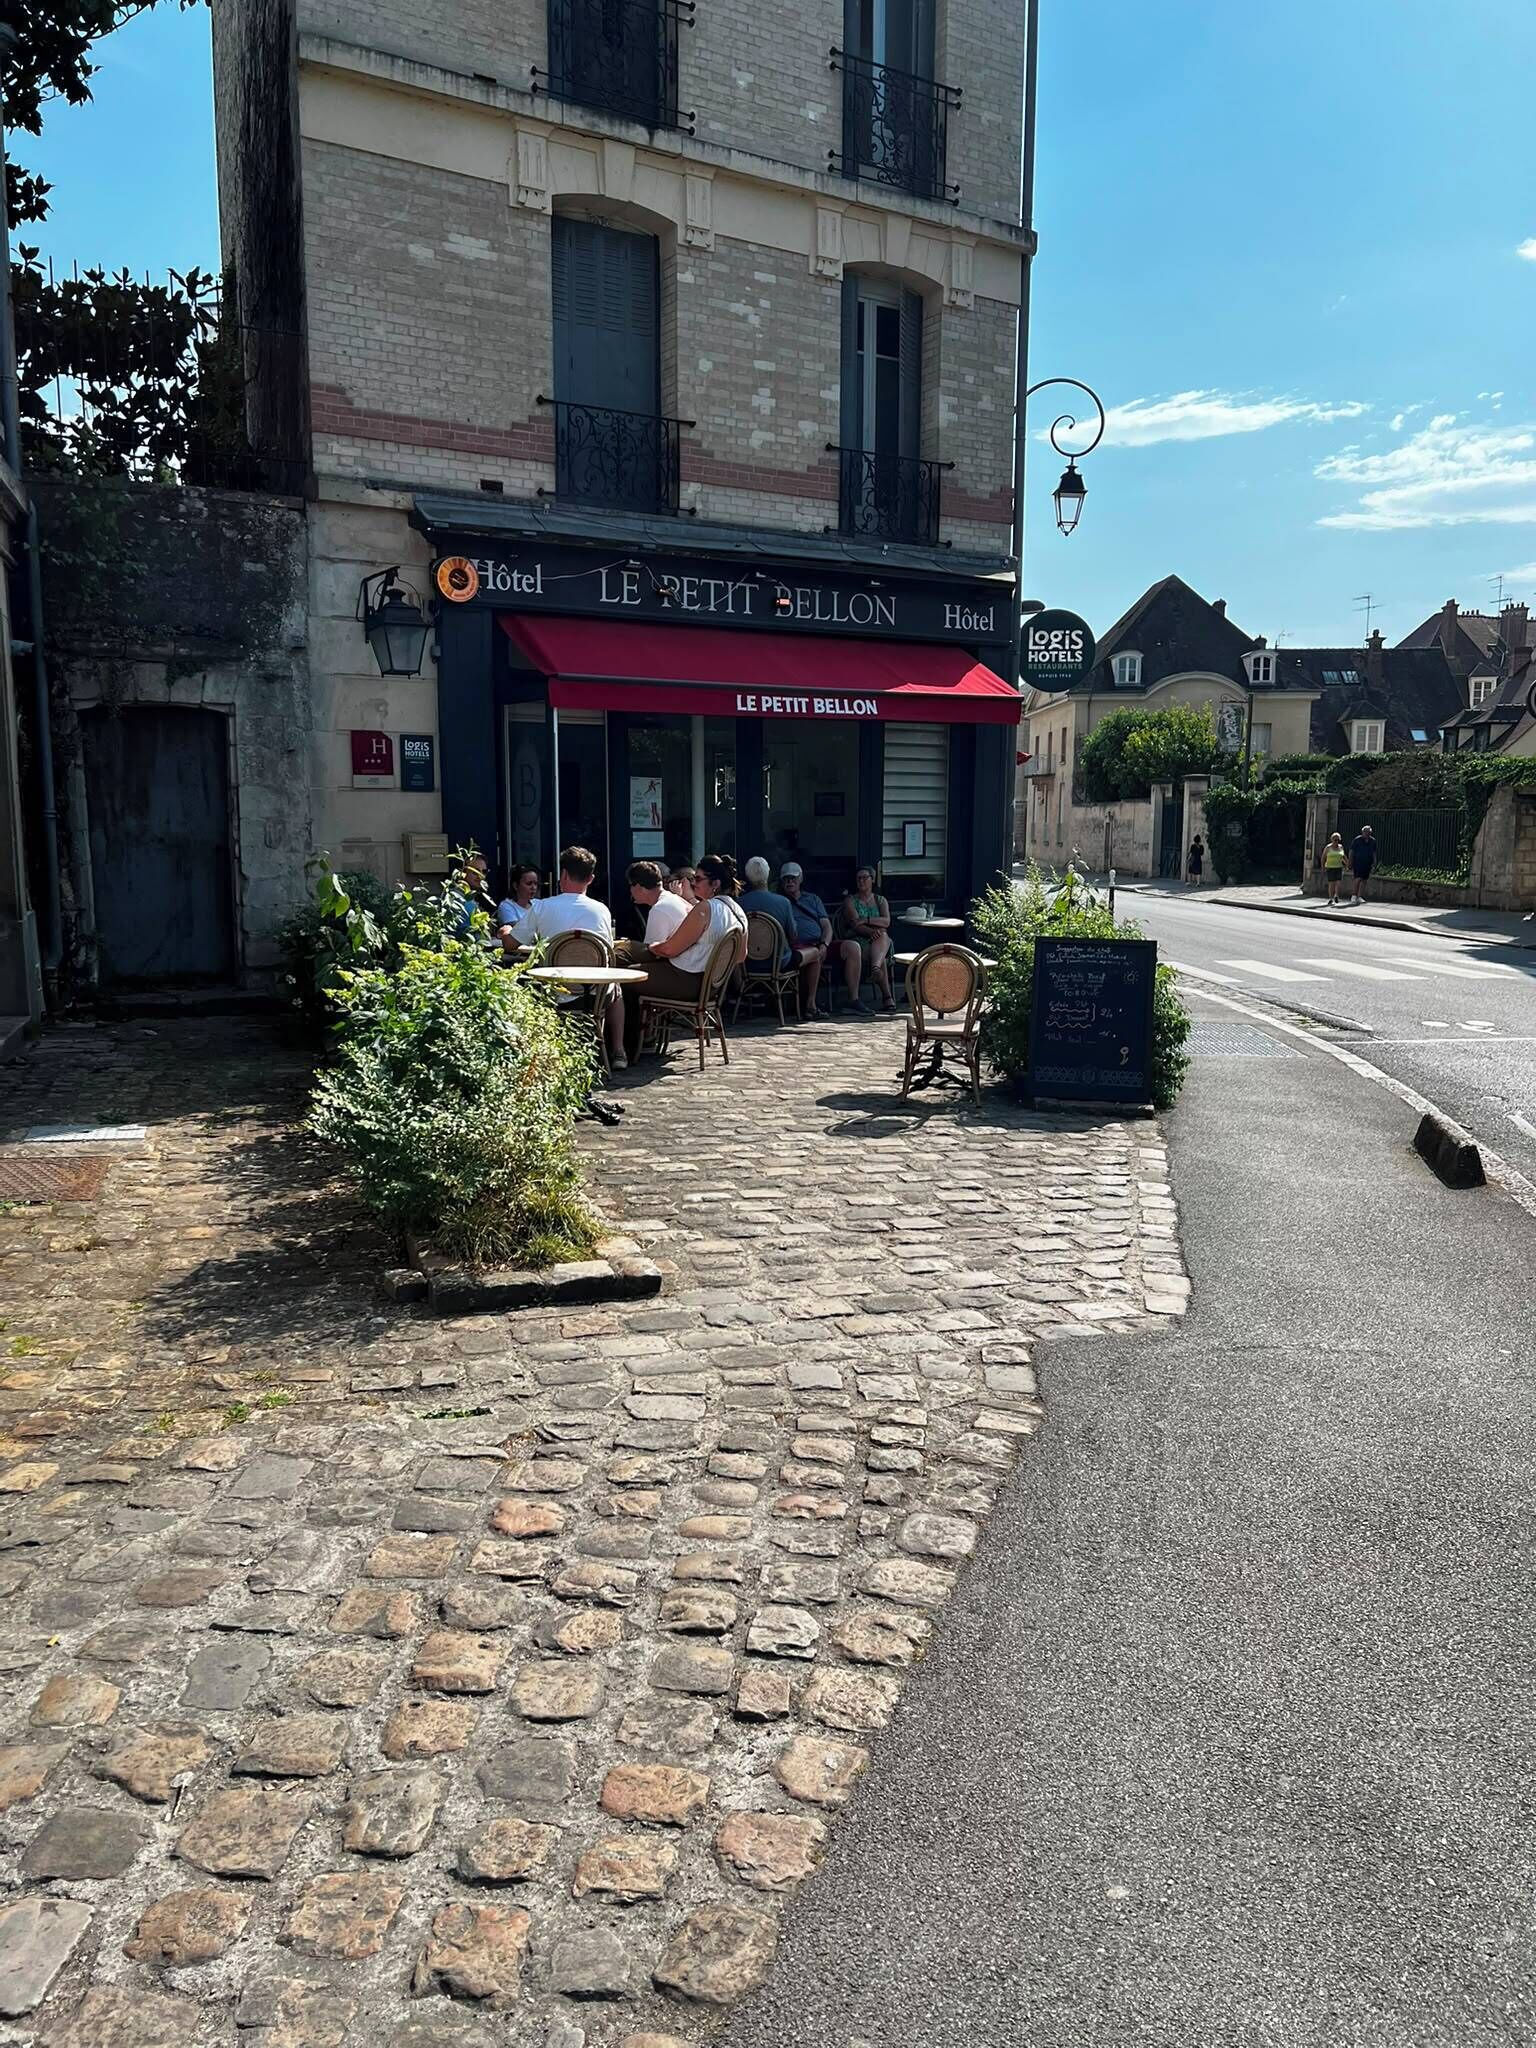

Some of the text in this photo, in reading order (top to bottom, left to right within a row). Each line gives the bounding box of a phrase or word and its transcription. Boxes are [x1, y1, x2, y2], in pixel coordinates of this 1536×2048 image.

[471, 558, 544, 594] Hôtel
[600, 568, 897, 627] LE PETIT BELLON
[943, 603, 995, 632] Hôtel
[1028, 650, 1083, 663] HOTELS
[736, 694, 878, 715] LE PETIT BELLON
[372, 738, 387, 754] H
